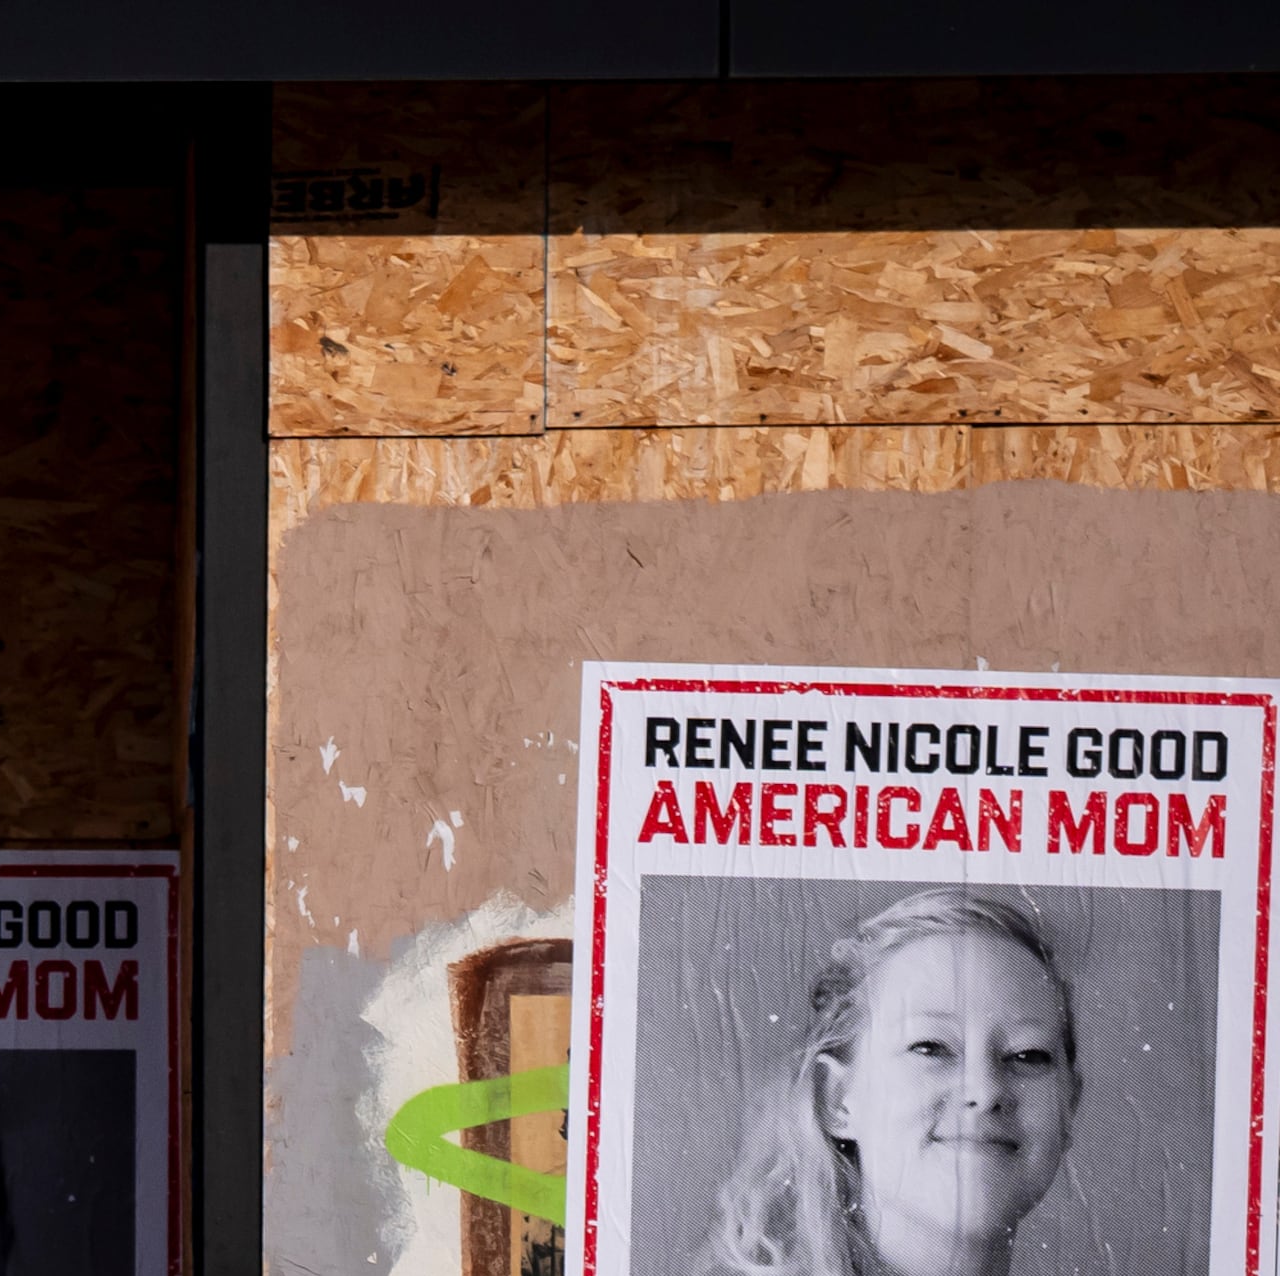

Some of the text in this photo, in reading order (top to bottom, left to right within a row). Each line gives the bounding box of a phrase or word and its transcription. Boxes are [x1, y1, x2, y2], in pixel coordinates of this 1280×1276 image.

[270, 173, 425, 213] ARBE
[646, 717, 1227, 781] RENEE NICOLE GOOD
[638, 781, 1226, 858] AMERICAN MOM
